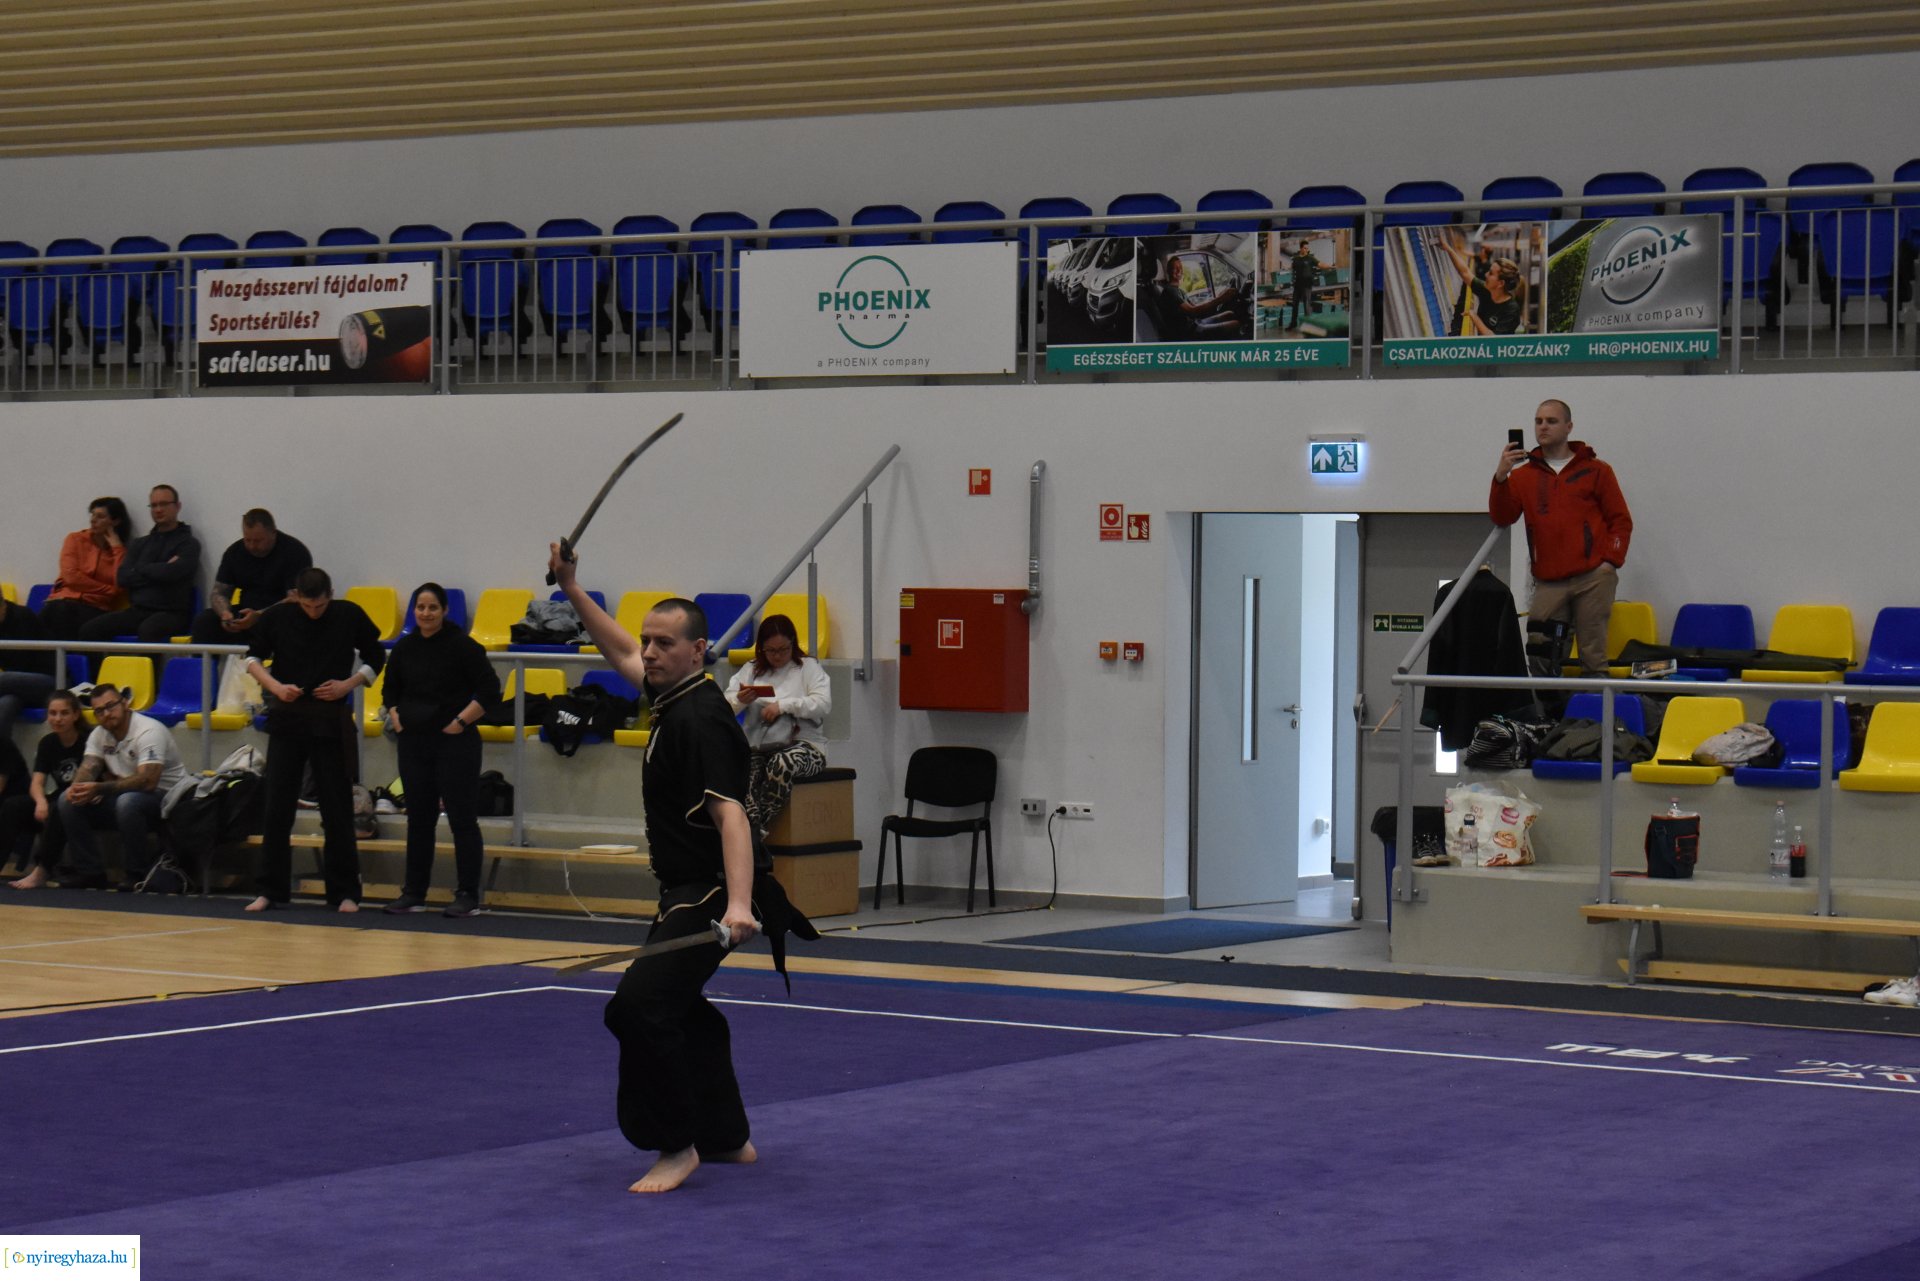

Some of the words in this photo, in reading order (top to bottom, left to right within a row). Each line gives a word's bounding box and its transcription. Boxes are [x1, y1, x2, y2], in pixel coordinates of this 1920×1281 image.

[1590, 229, 1692, 282] PHOENIX
[209, 277, 320, 301] Mozgásszervi
[323, 273, 409, 298] fájdalom?
[818, 289, 931, 312] PHOENIX
[209, 311, 321, 335] Sportsérülés?
[1588, 313, 1632, 327] PHOENIX
[1637, 305, 1705, 322] company
[208, 349, 331, 374] safelaser.hu
[1073, 351, 1154, 366] EGÉSZSÉGET
[1157, 349, 1237, 364] SZÁLLÍTUNK
[1241, 349, 1271, 363] MÁR
[1274, 350, 1290, 362] 25
[1294, 346, 1320, 361] ÉVE
[1388, 343, 1494, 361] CSATLAKOZNÁL
[1497, 343, 1571, 359] HOZZÁNK?
[1588, 340, 1711, 356] HR@PHOENIX.HU
[817, 360, 823, 368] a
[828, 357, 878, 367] PHOENIX
[882, 357, 931, 368] company
